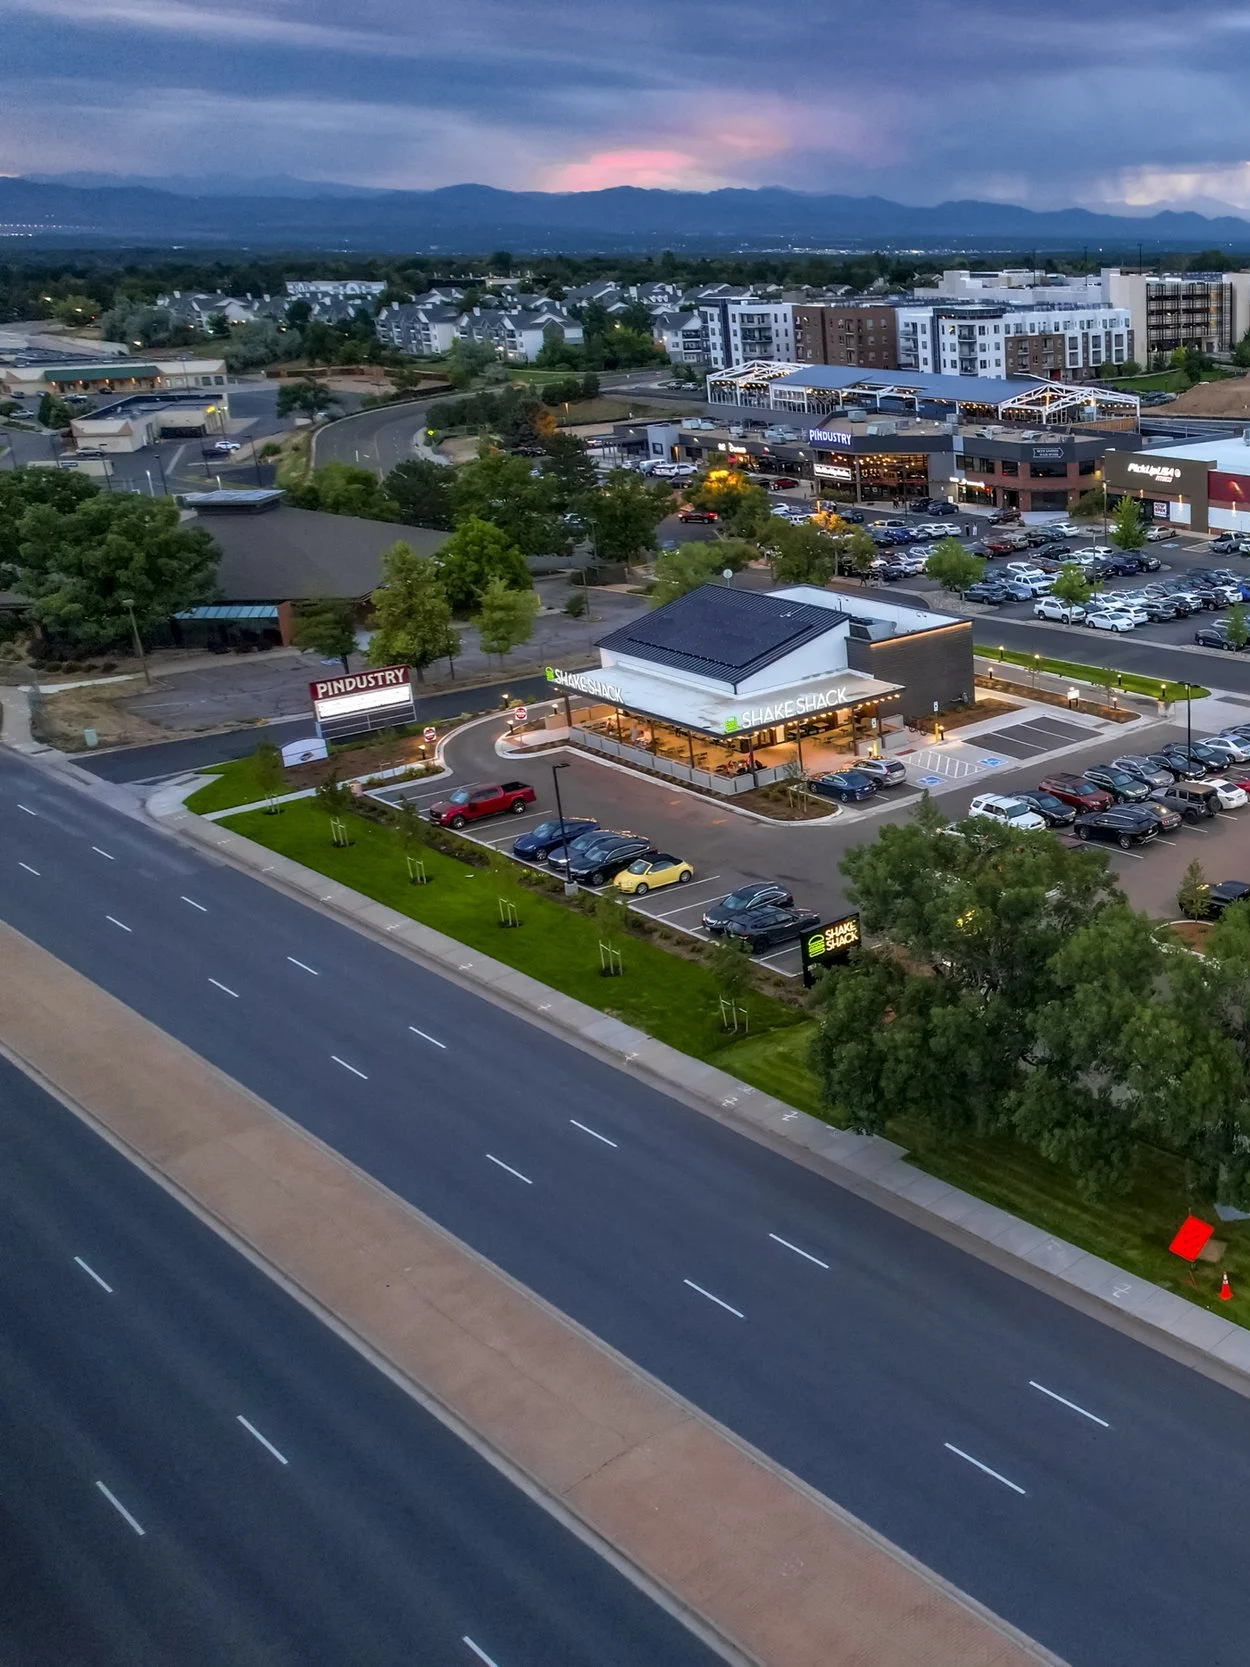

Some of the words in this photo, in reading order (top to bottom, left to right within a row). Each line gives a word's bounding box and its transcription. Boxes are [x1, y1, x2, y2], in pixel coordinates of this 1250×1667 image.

[809, 429, 852, 445] PINDUSTRY
[316, 668, 405, 698] PINDUSTRY
[554, 669, 588, 692] SHAKE
[587, 680, 624, 703] SHACK
[742, 700, 794, 729] SHAKE
[796, 687, 848, 714] SHACK
[825, 920, 857, 940] SHAKE
[826, 930, 859, 951] SHACK
